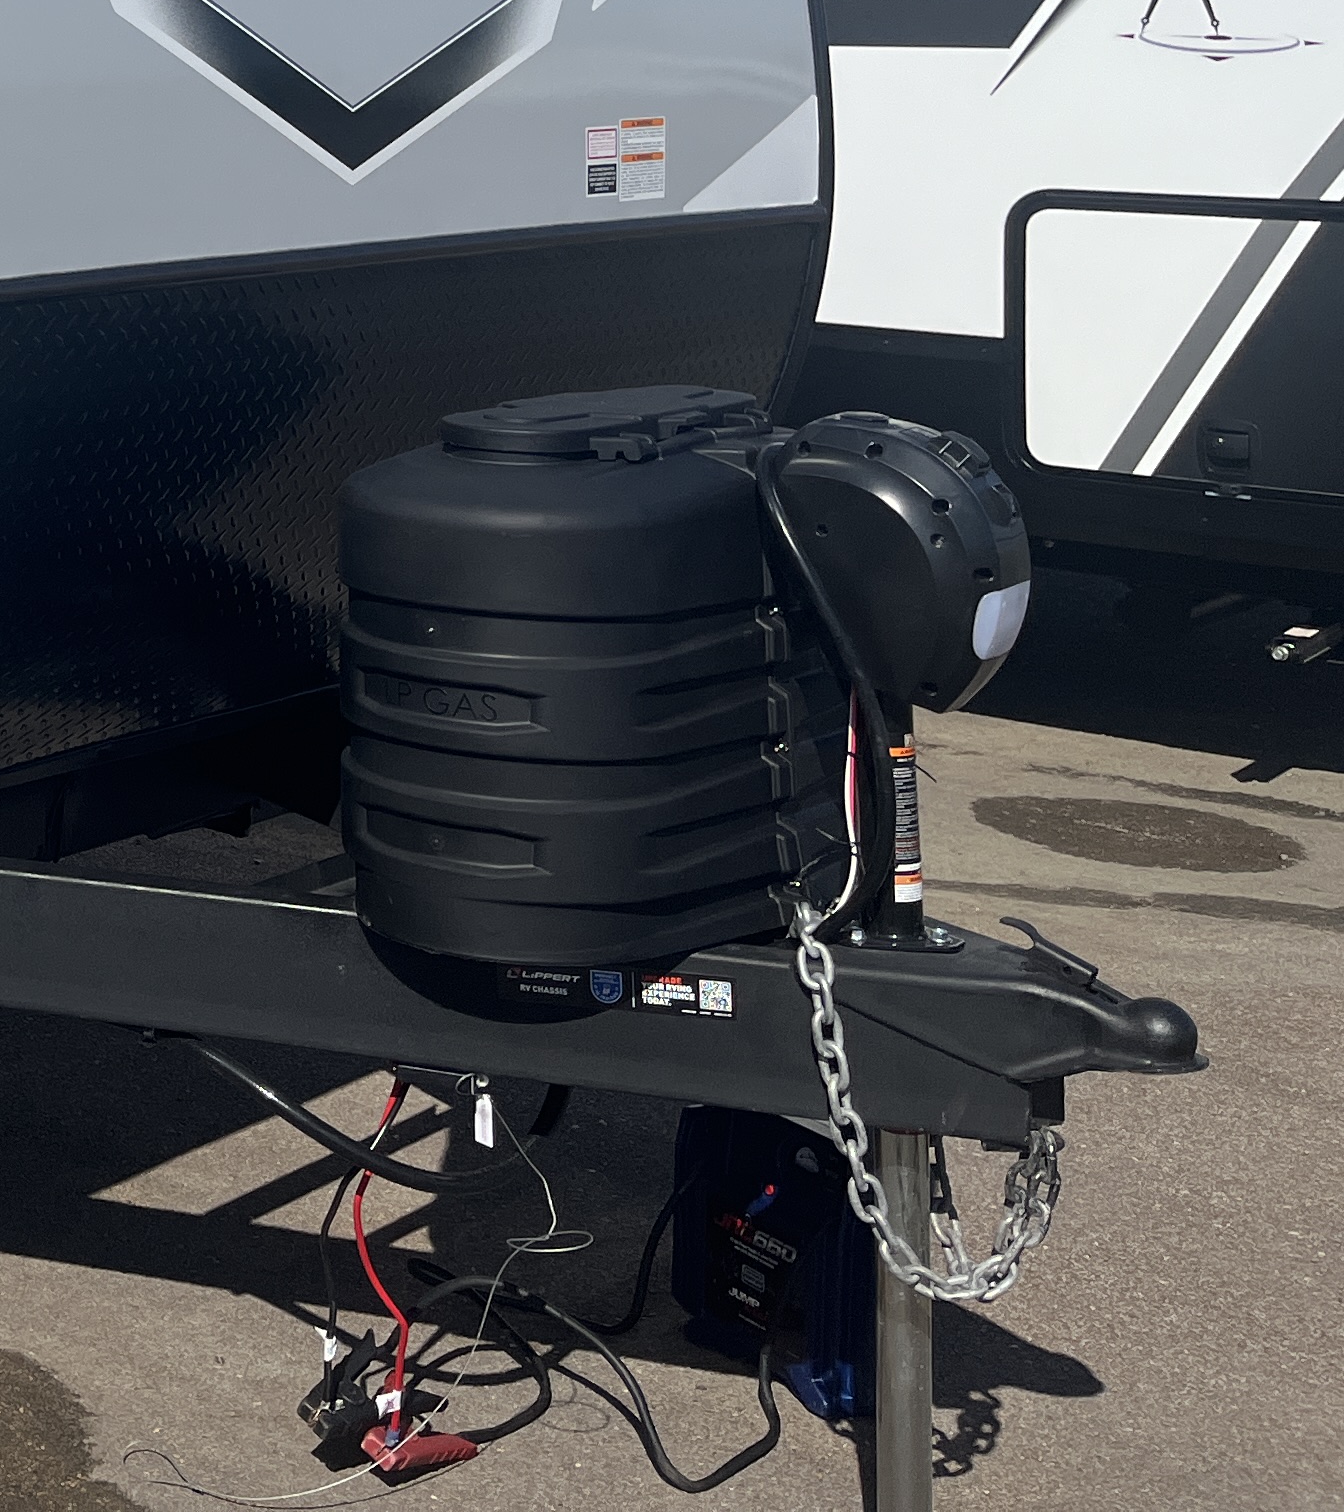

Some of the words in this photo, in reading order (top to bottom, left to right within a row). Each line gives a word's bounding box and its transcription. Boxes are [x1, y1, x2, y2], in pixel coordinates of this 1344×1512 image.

[423, 687, 498, 721] GAS
[520, 984, 531, 992] RV
[532, 985, 568, 996] CHASSIS
